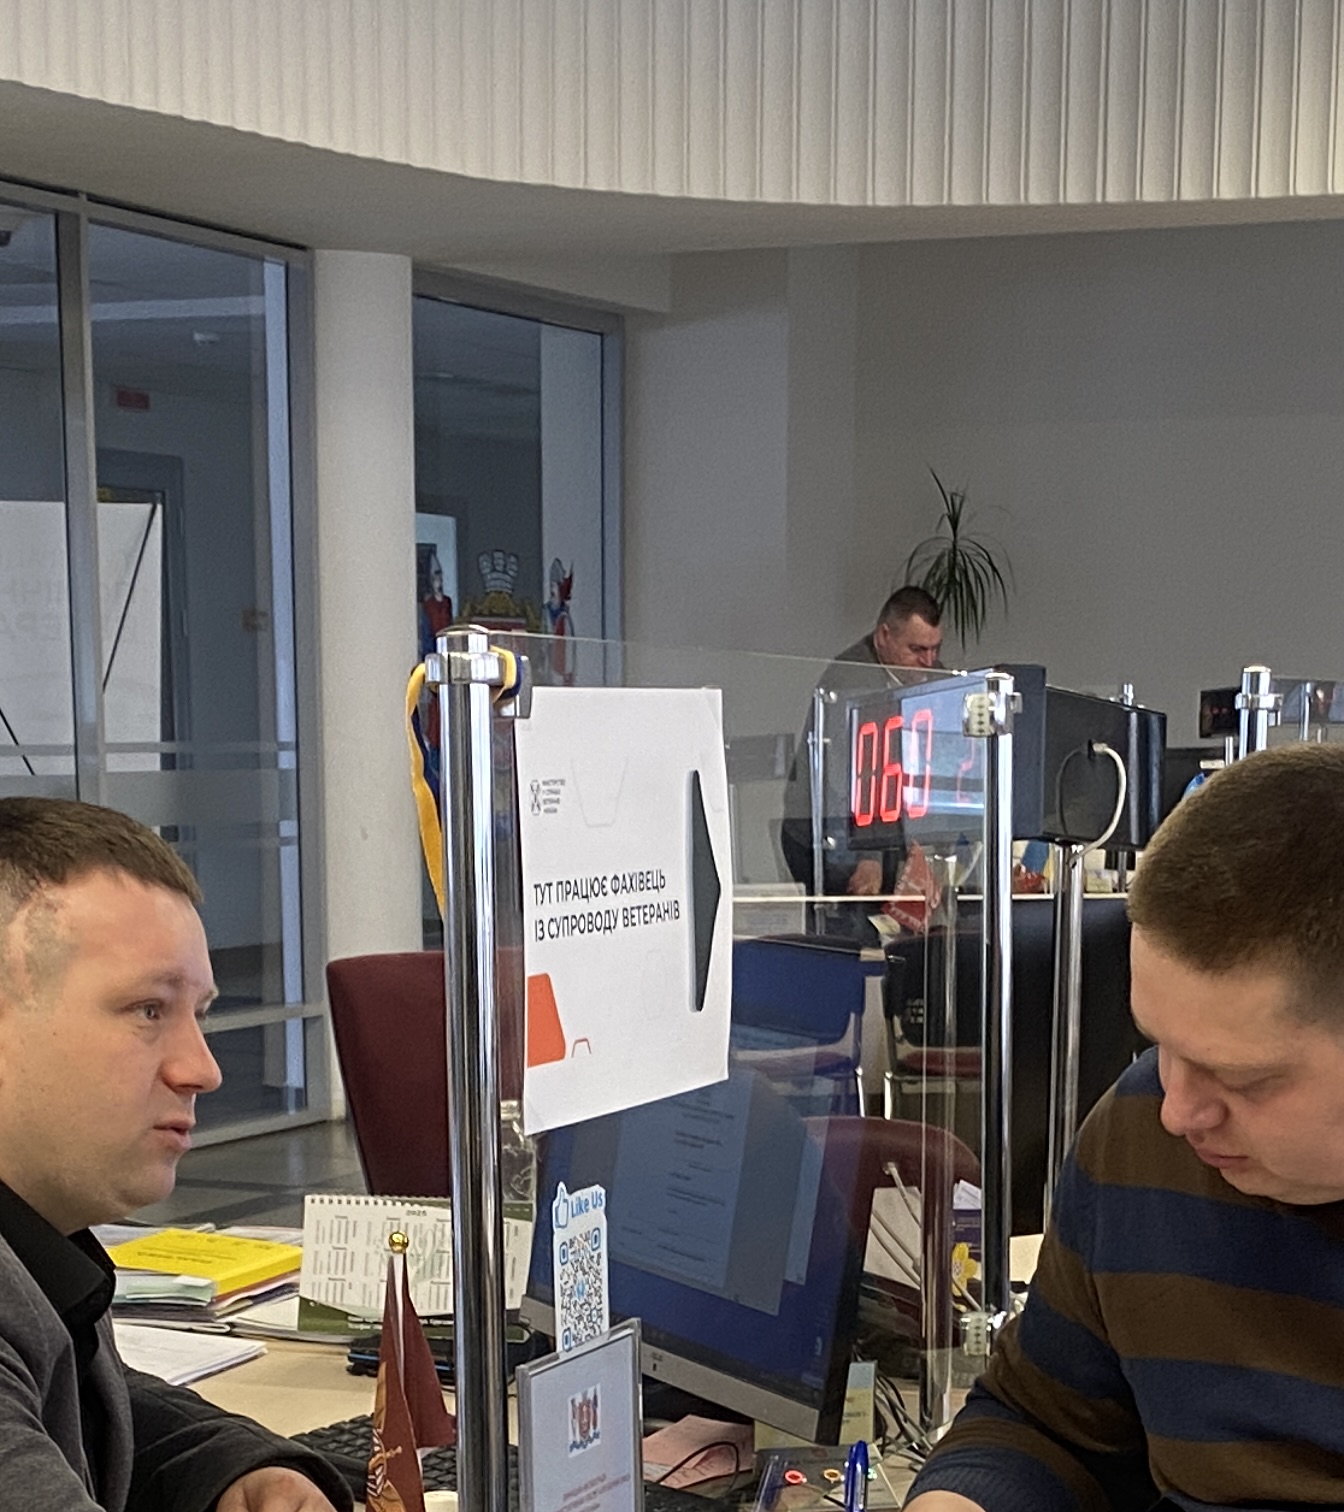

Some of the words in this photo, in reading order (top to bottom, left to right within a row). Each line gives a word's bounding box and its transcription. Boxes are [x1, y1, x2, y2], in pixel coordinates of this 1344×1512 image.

[855, 708, 933, 827] 060
[533, 880, 554, 906] ТУТ
[556, 876, 608, 903] ПРАЦЮЄ
[610, 868, 667, 896] ФАХІВЕЦЬ
[534, 919, 545, 942] ІЗ
[547, 908, 620, 940] СУПРОВОДУ
[622, 899, 681, 928] ВЕТЕРАНІВ
[570, 1196, 590, 1218] Like
[591, 1190, 604, 1210] Us
